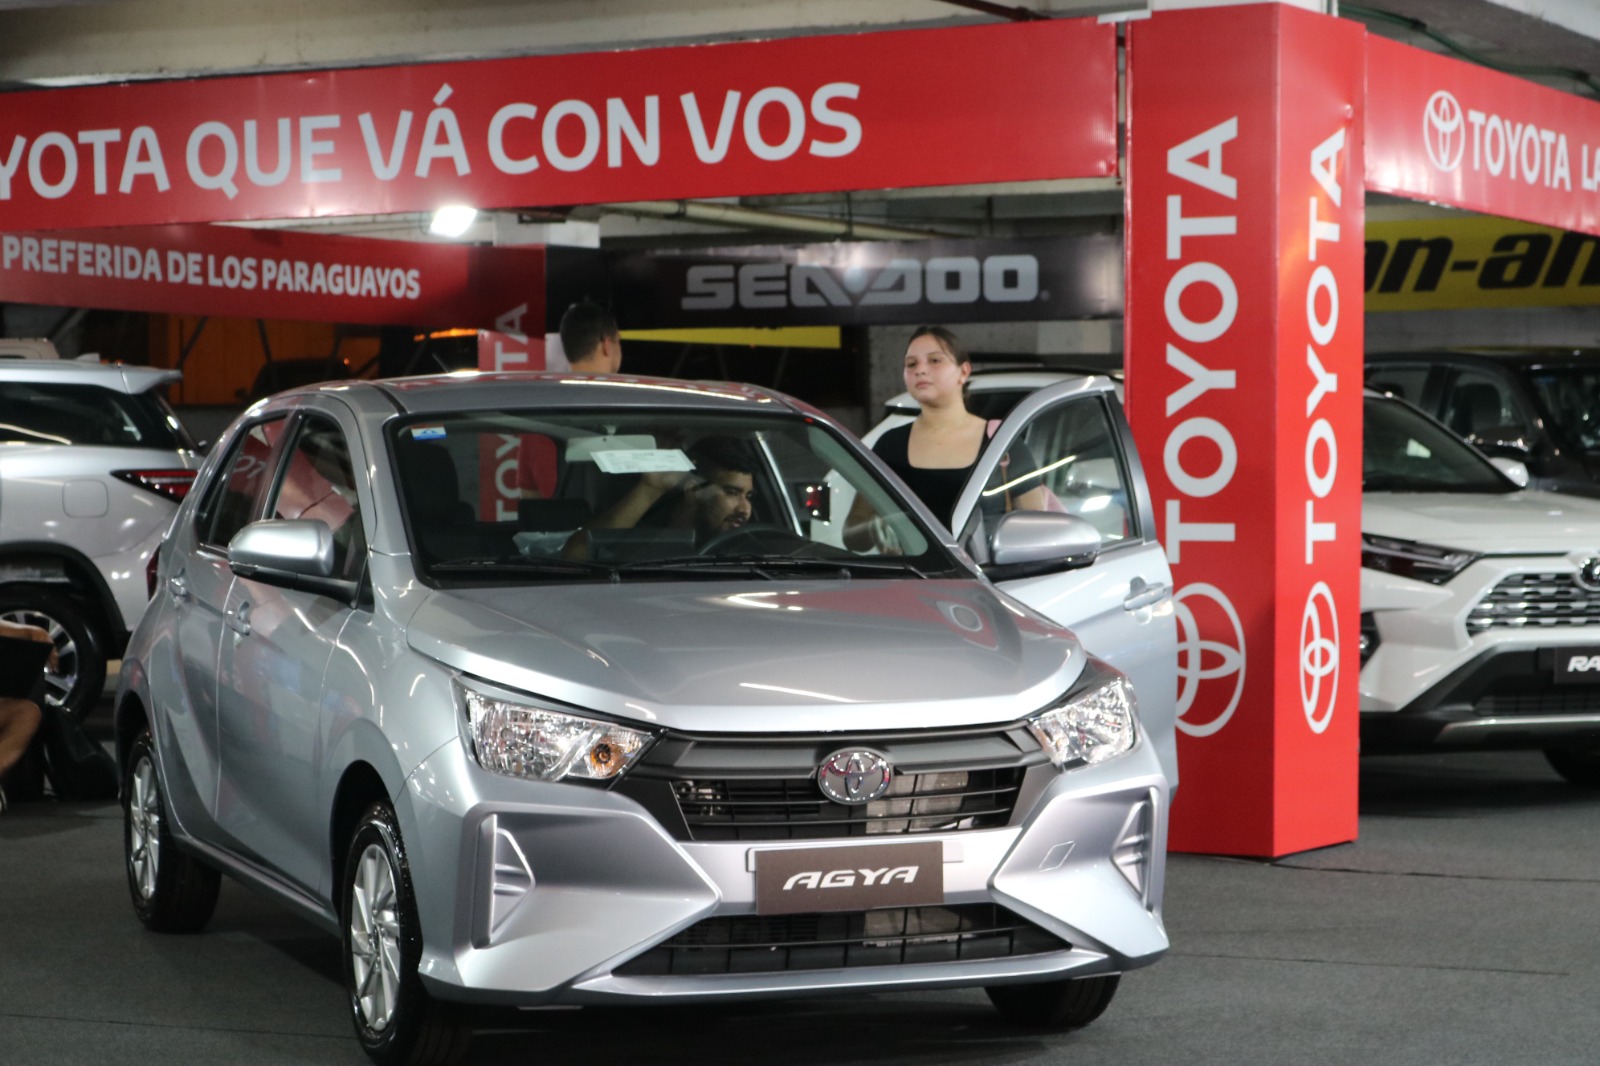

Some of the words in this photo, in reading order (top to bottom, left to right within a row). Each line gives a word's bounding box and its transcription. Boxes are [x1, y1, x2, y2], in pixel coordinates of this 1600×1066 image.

[186, 115, 342, 200] QUE
[358, 83, 471, 181] VÁ
[487, 95, 660, 176] CON
[680, 82, 862, 164] VOS
[1468, 109, 1572, 192] TOYOTA
[3, 235, 163, 283] PREFERIDA
[167, 251, 203, 285] DE
[207, 254, 258, 290] LOS
[262, 258, 420, 300] PARAGUAYOS
[1164, 116, 1239, 565] TOYOTA
[1305, 127, 1346, 565] TOYOTA
[782, 865, 919, 891] AGYA
